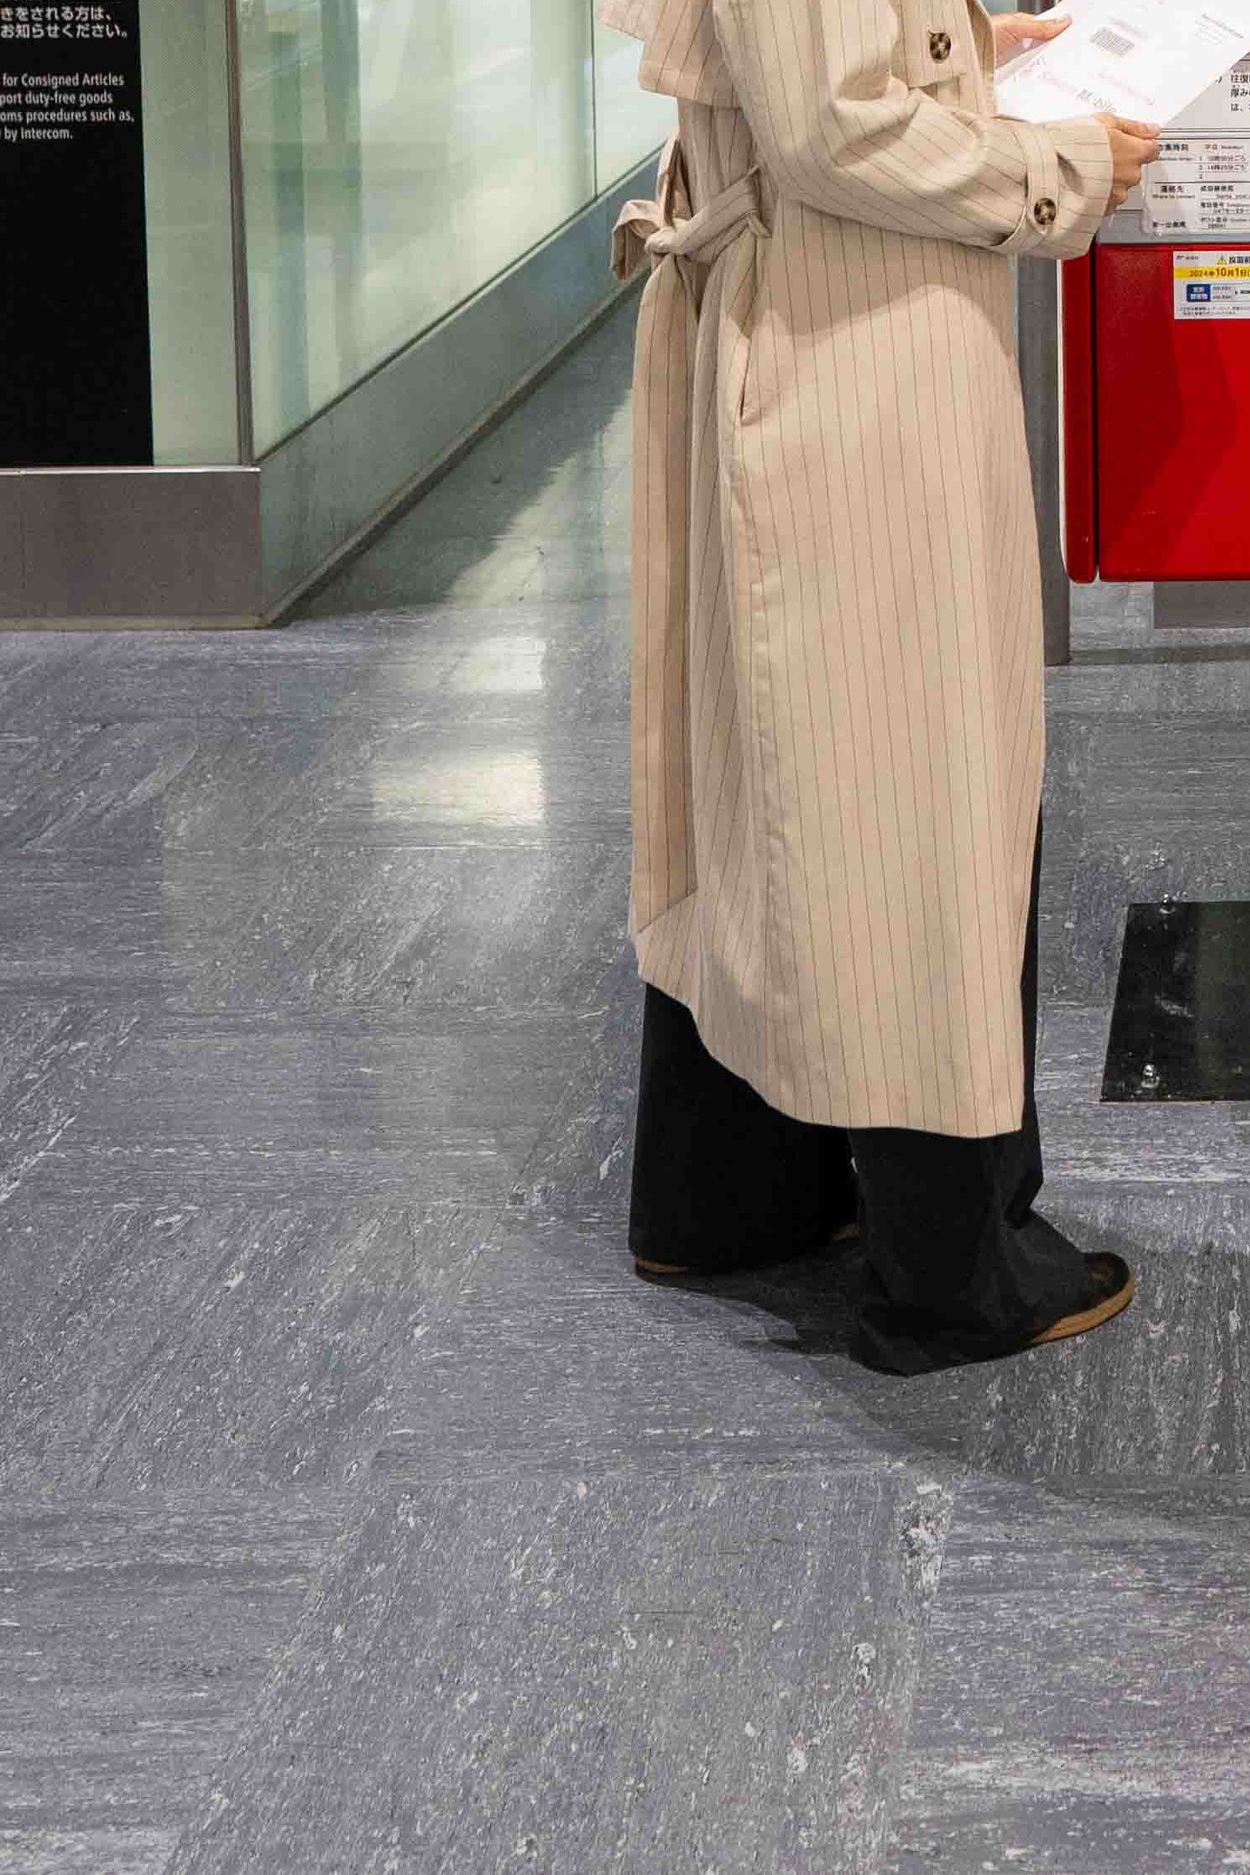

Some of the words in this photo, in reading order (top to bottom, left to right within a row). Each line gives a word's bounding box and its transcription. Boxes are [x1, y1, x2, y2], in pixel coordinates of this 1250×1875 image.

[0, 24, 128, 39] お知らせください。
[3, 72, 18, 86] for
[21, 72, 79, 89] Consigned
[82, 71, 125, 86] Articles
[25, 90, 76, 107] duty-free
[79, 88, 113, 107] goods
[26, 108, 88, 125] procedures
[90, 107, 115, 122] such
[119, 110, 135, 123] as,
[4, 125, 18, 143] by
[20, 126, 73, 139] intercom.
